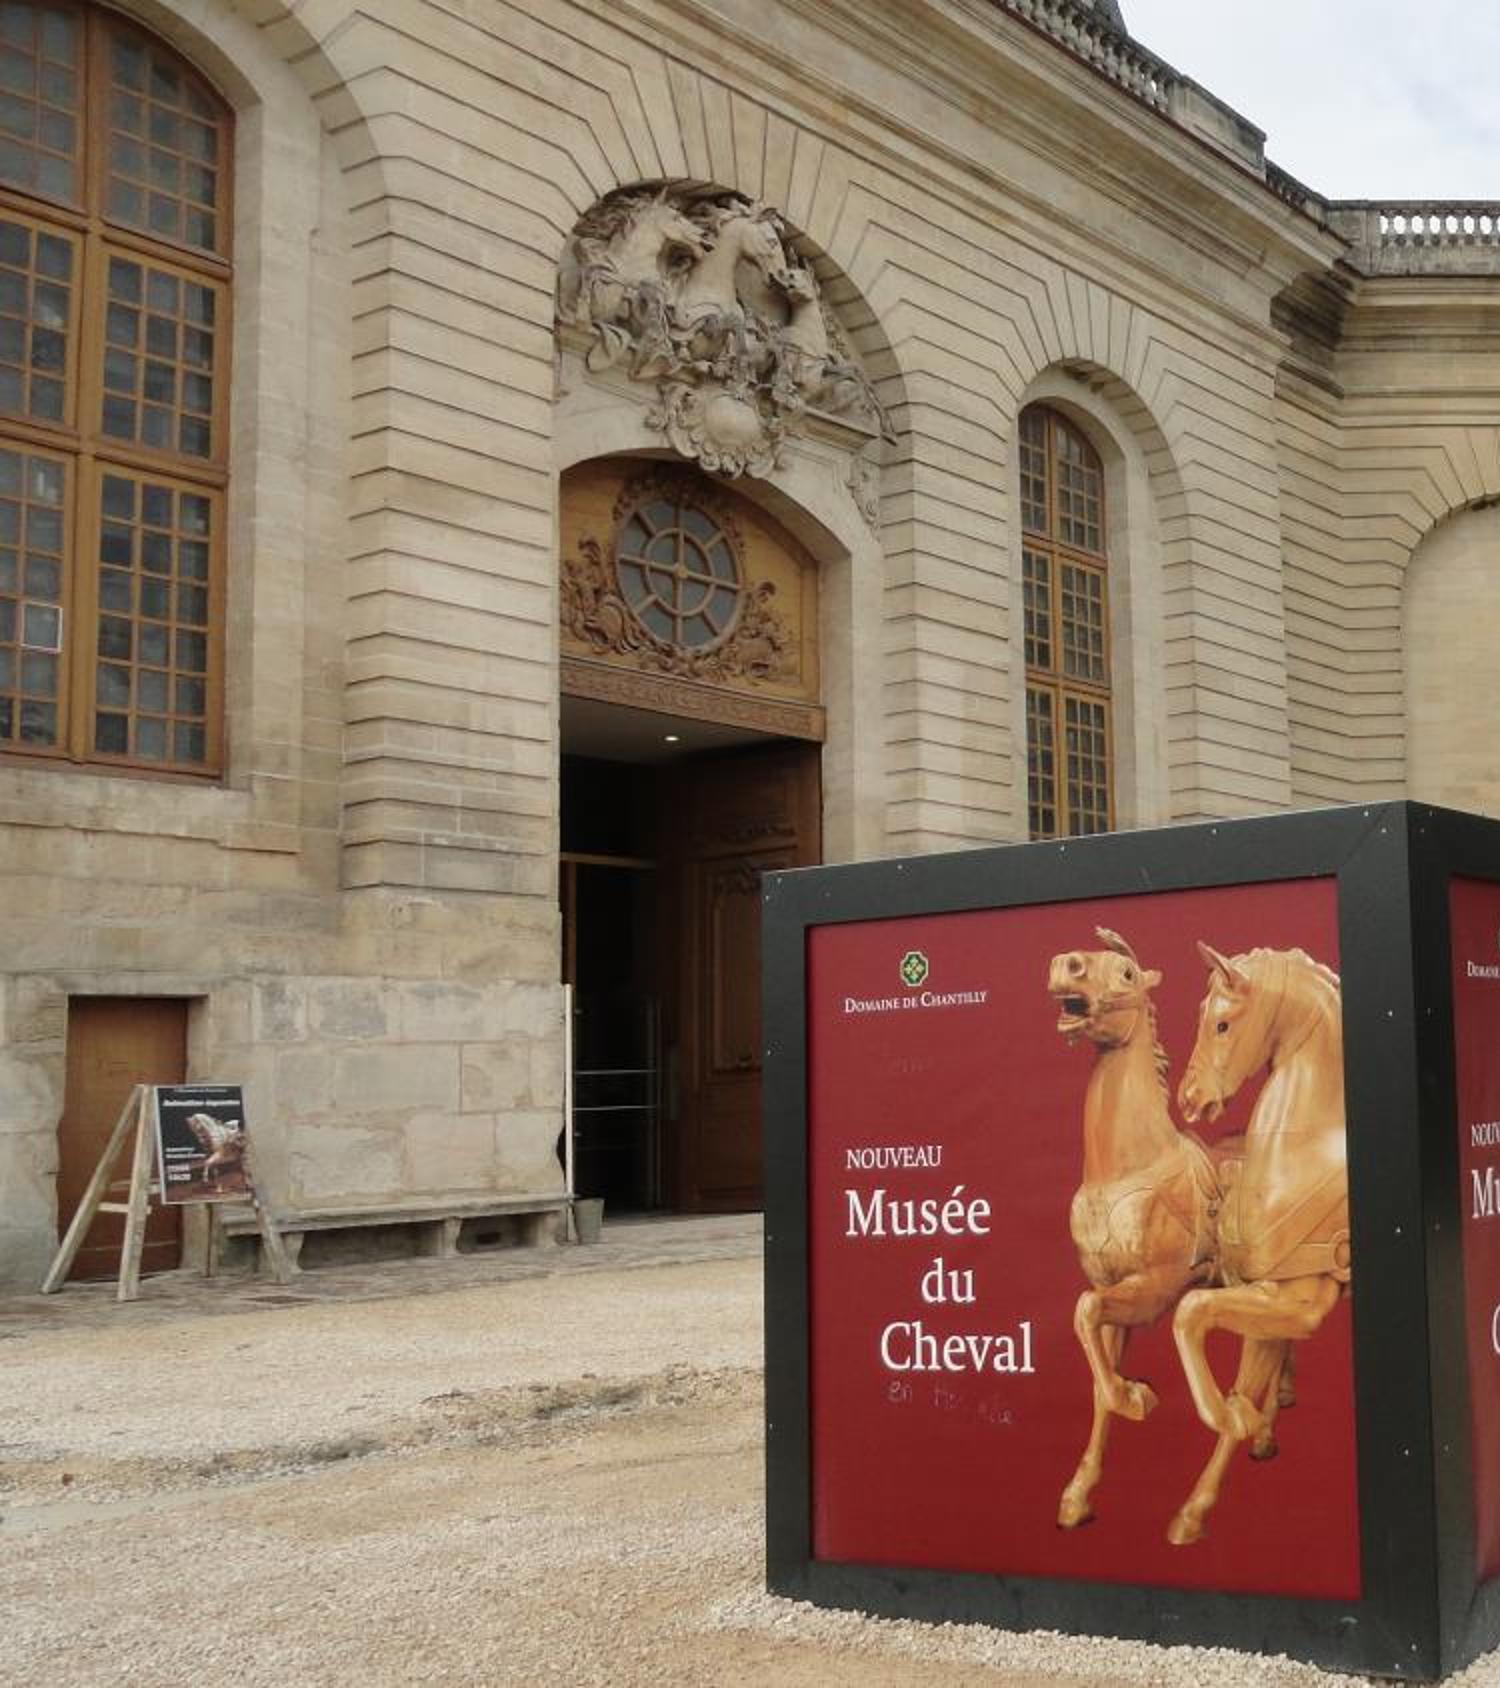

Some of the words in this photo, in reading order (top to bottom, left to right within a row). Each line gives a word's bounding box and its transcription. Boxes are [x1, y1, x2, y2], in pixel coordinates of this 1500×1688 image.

[844, 997, 900, 1013] DOMAINE
[902, 997, 918, 1009] DE
[920, 991, 988, 1007] CHANTILLY
[846, 1145, 942, 1169] NOUVEAU
[845, 1185, 991, 1236] Musée
[920, 1256, 977, 1303] du
[880, 1320, 1036, 1373] Cheval
